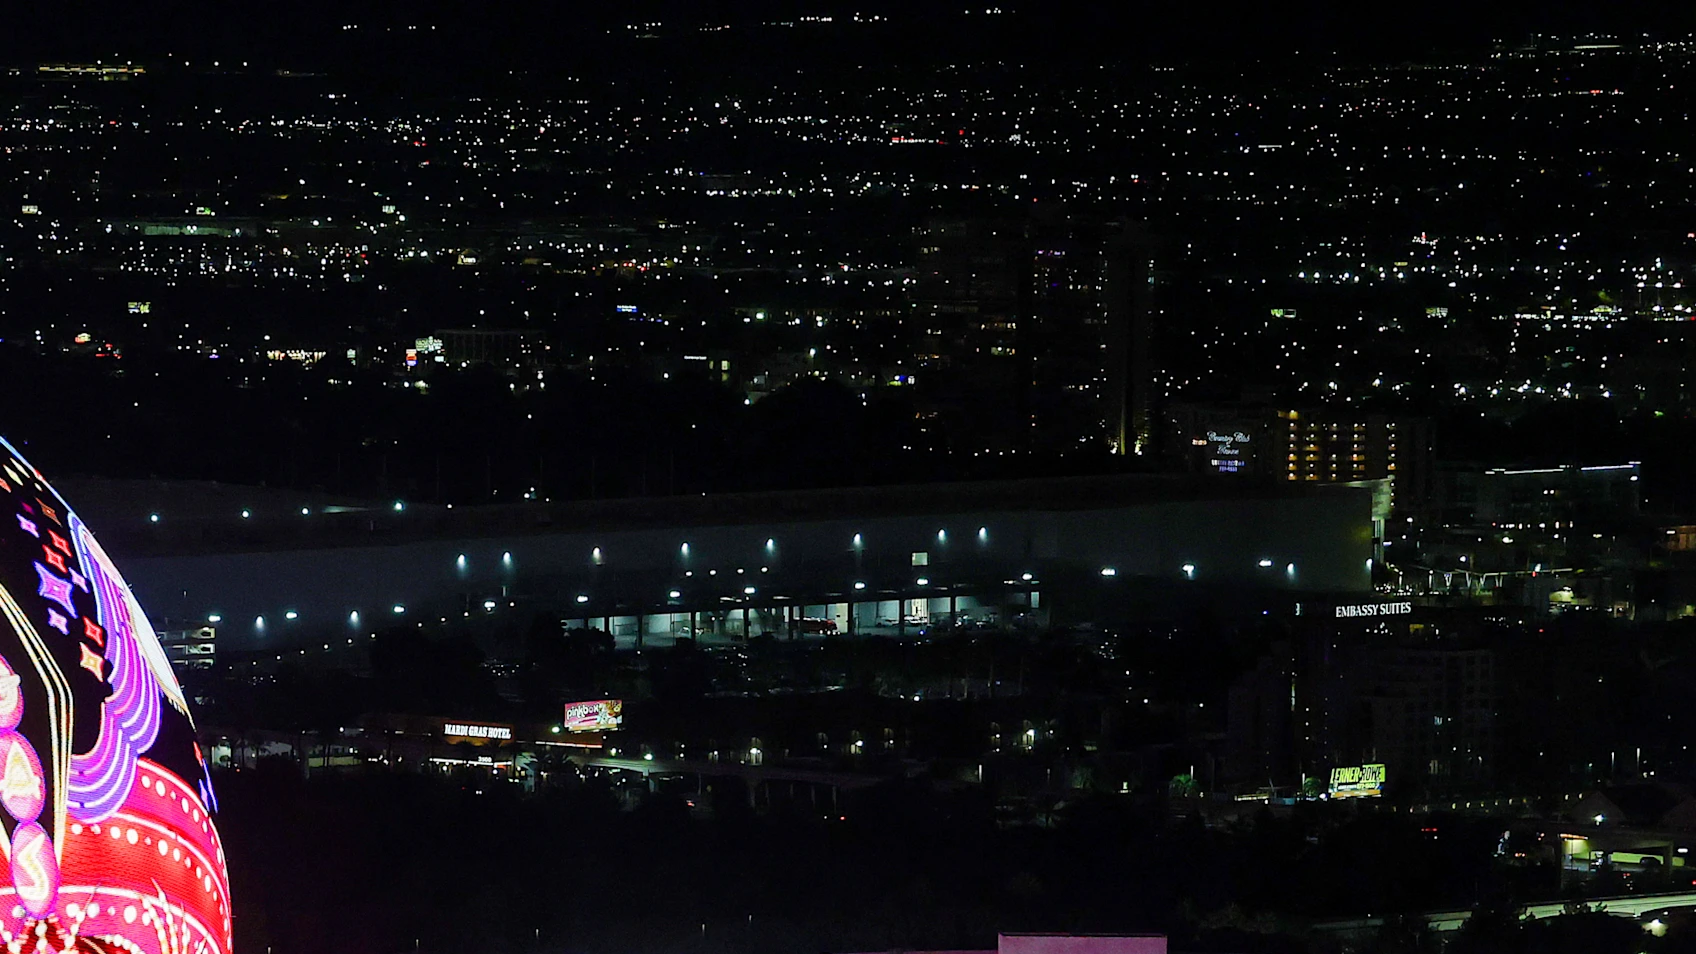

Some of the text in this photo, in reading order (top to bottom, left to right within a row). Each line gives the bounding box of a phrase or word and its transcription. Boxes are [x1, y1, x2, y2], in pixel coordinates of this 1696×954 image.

[1335, 602, 1412, 618] EMBASSY SUITES
[566, 703, 600, 720] pinkbox
[444, 723, 512, 740] MARDI GRAS HOTEL
[1329, 767, 1361, 784] LERNER
